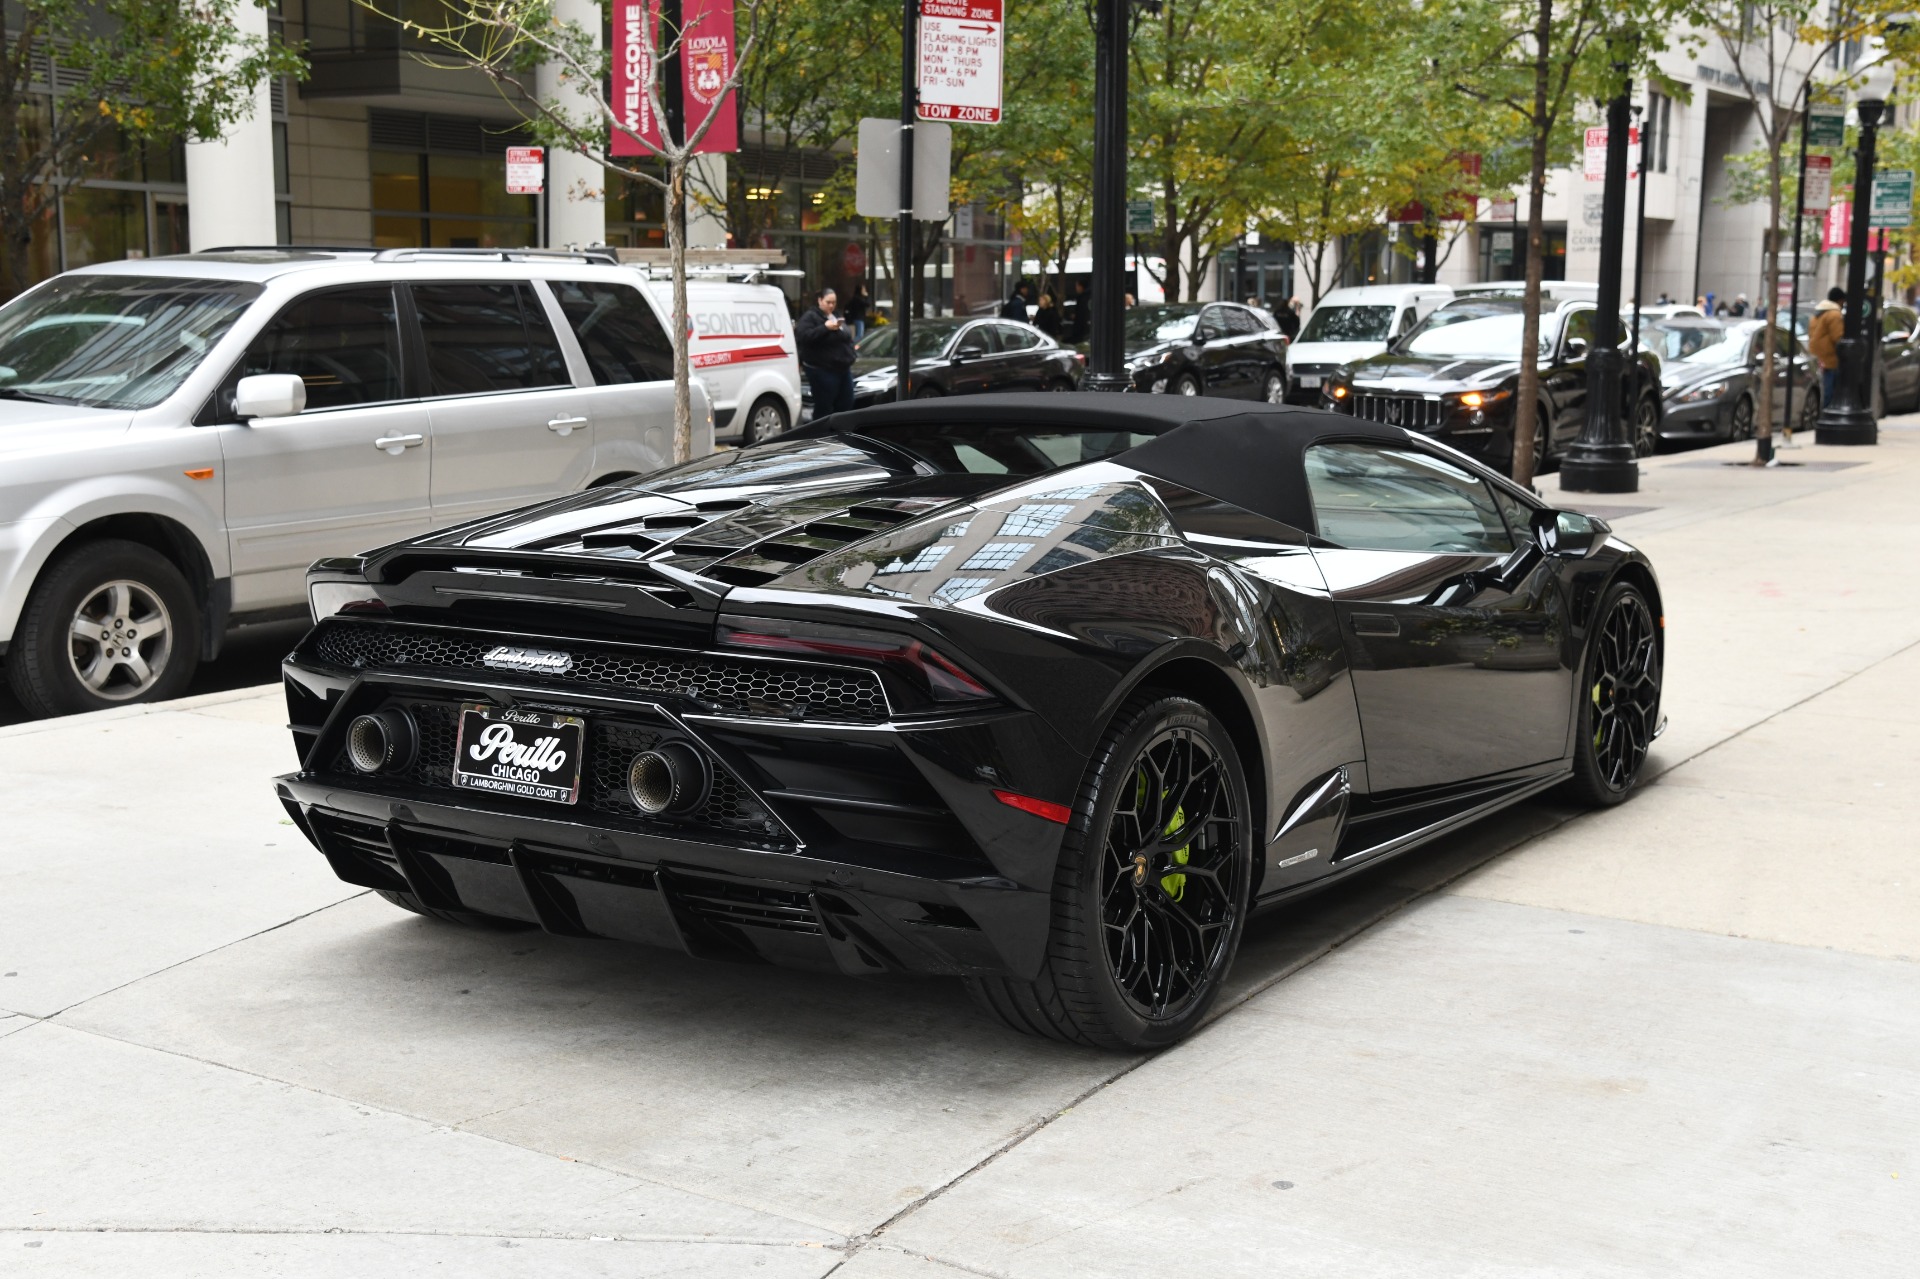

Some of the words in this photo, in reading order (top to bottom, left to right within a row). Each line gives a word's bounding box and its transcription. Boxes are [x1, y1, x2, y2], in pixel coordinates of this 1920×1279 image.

[924, 5, 967, 17] STANDING
[971, 8, 994, 19] ZONE
[924, 22, 941, 32] USE
[688, 36, 728, 49] LOYOLA
[924, 33, 966, 45] FLASHING
[968, 37, 997, 47] LIGHTS
[924, 44, 933, 52] 10
[935, 45, 948, 53] AM
[957, 47, 963, 55] 8
[966, 47, 978, 56] PM
[625, 5, 640, 131] WELCOME
[924, 54, 943, 64] MON
[954, 57, 983, 68] THURS
[924, 65, 932, 74] 10
[934, 66, 947, 75] AM
[957, 69, 962, 77] 6
[964, 68, 977, 77] PM
[923, 76, 938, 85] FRI
[946, 78, 965, 87] SUN
[641, 97, 649, 134] WATER
[922, 104, 951, 118] TOW
[957, 106, 993, 120] ZONE
[695, 312, 781, 335] SONITROL
[483, 646, 569, 668] Lamborghini
[501, 710, 541, 724] Perillo
[469, 723, 567, 772] Perillo
[491, 764, 540, 783] CHICAGO
[470, 778, 516, 792] LAMBORGHINI
[516, 784, 535, 795] GOLD
[536, 787, 558, 798] COAST
